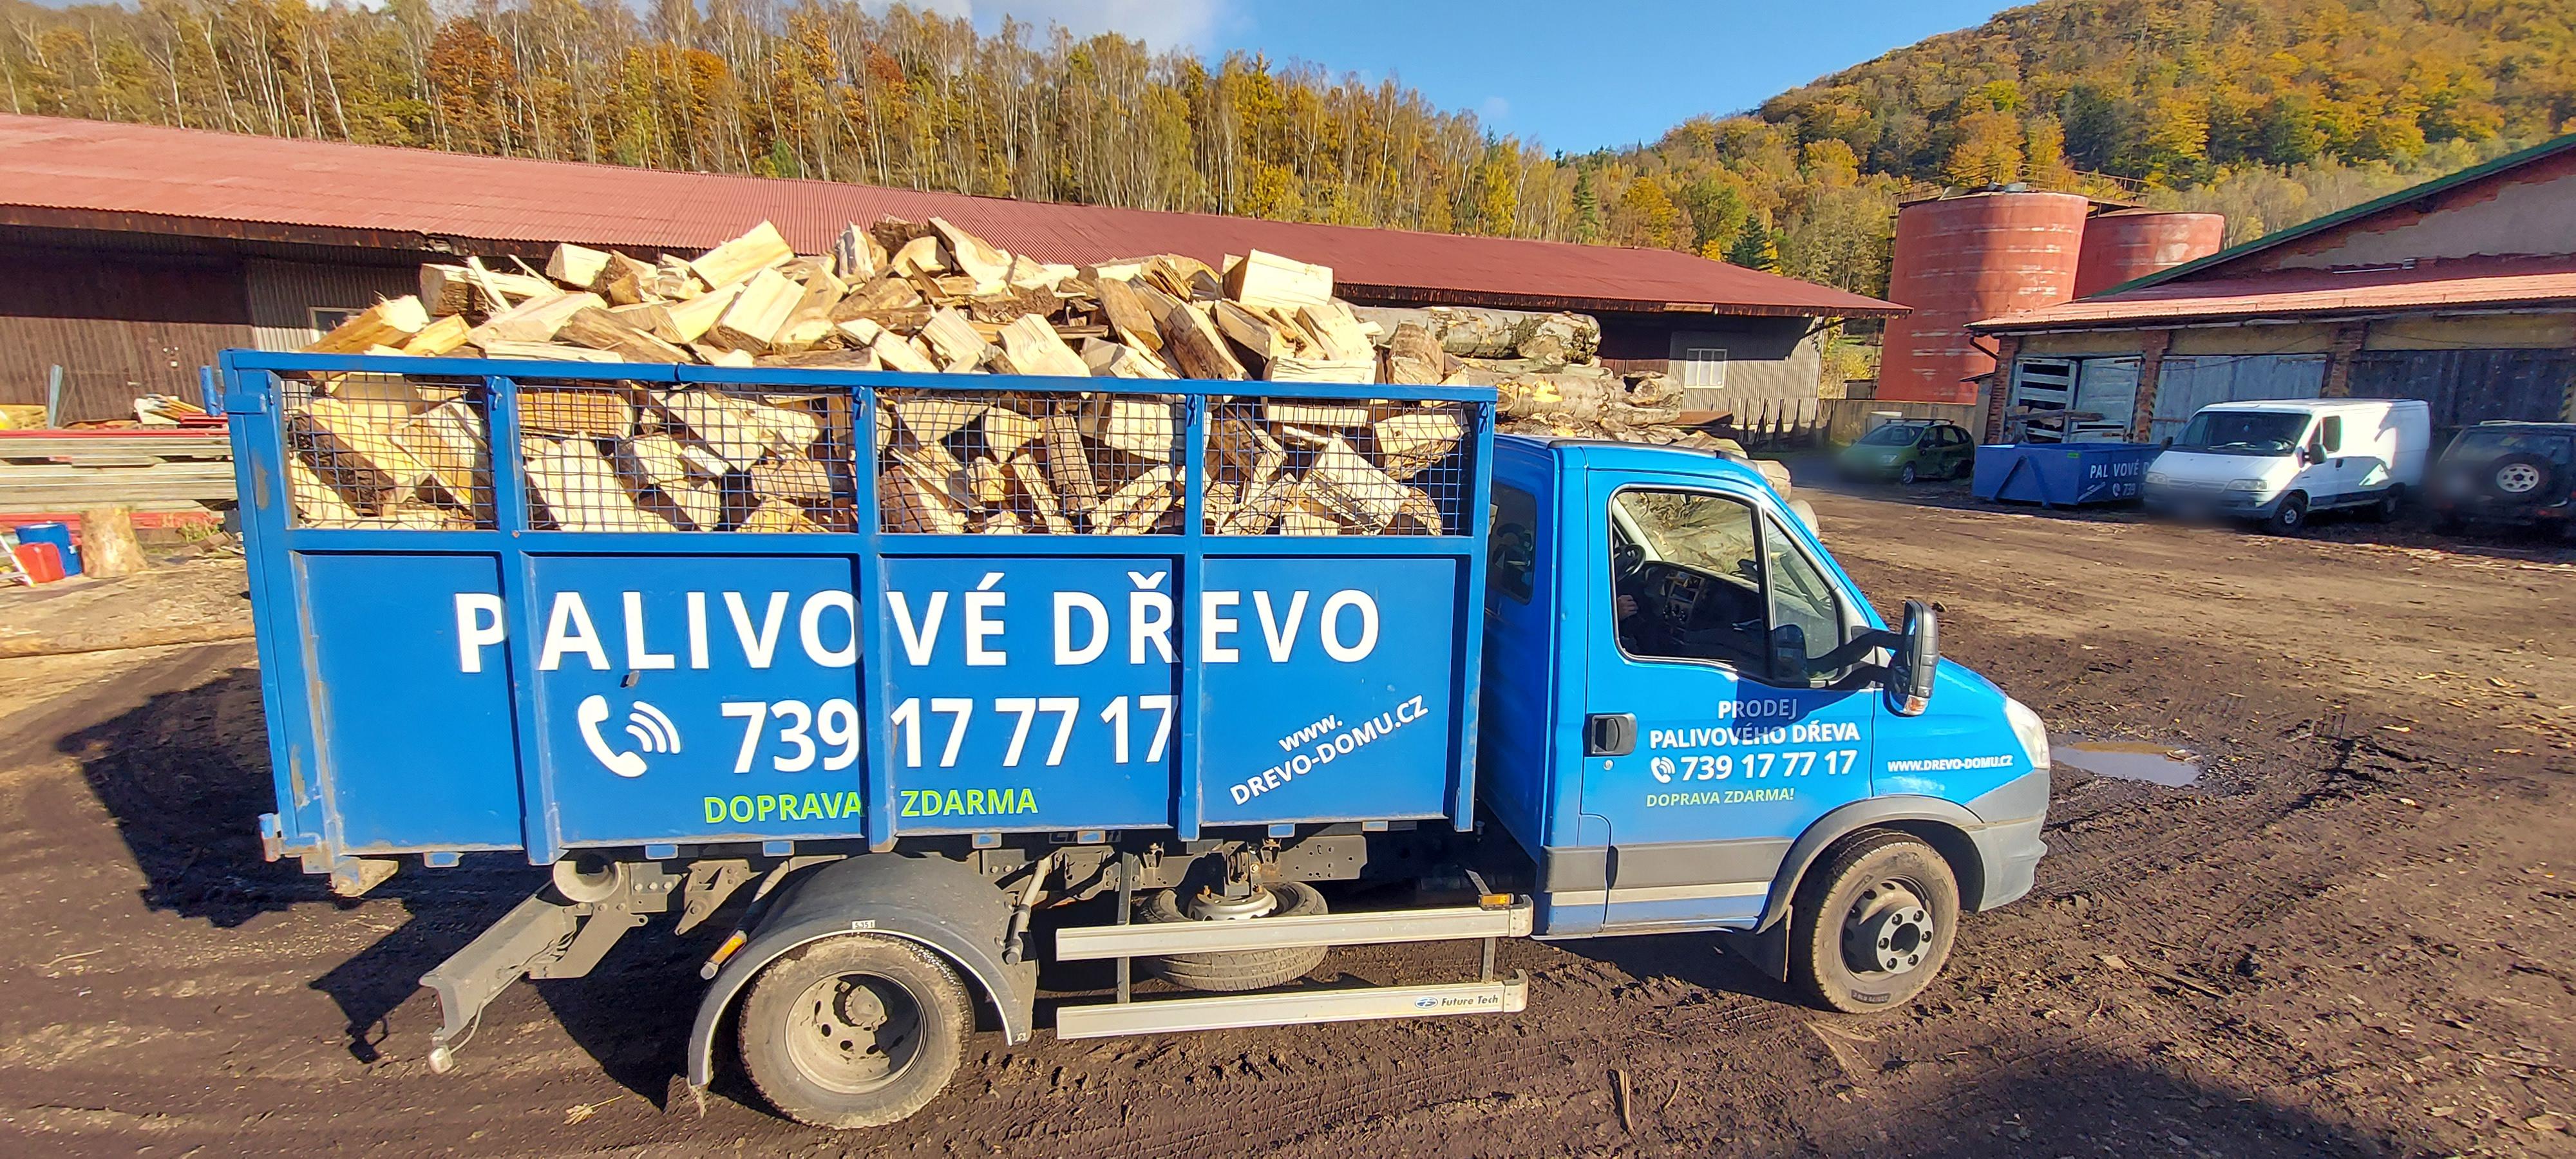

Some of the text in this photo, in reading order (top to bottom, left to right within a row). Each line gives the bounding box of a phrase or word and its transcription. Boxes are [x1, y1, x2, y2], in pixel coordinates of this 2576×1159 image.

[2090, 458, 2139, 478] PALVOVÉ
[454, 570, 1379, 673] PALIVOVÉ DŘEVO
[1718, 699, 1797, 719] PRODEJ
[720, 694, 1179, 774] 739 17 77 17
[1278, 714, 1343, 751] www.
[1650, 720, 1861, 749] PALIVOVÉHO DŘEVA
[1229, 695, 1428, 805] DREVO-DOMU.CZ
[1680, 749, 1857, 781] 739 17 77 17
[1888, 755, 2014, 772] WWW.DREVO-DOMU.CZ
[703, 787, 1039, 824] DOPRAVA ZDARMA
[1647, 787, 1794, 807] DOPRAVA ZDARMA!
[1441, 994, 1499, 1006] Future Tech
